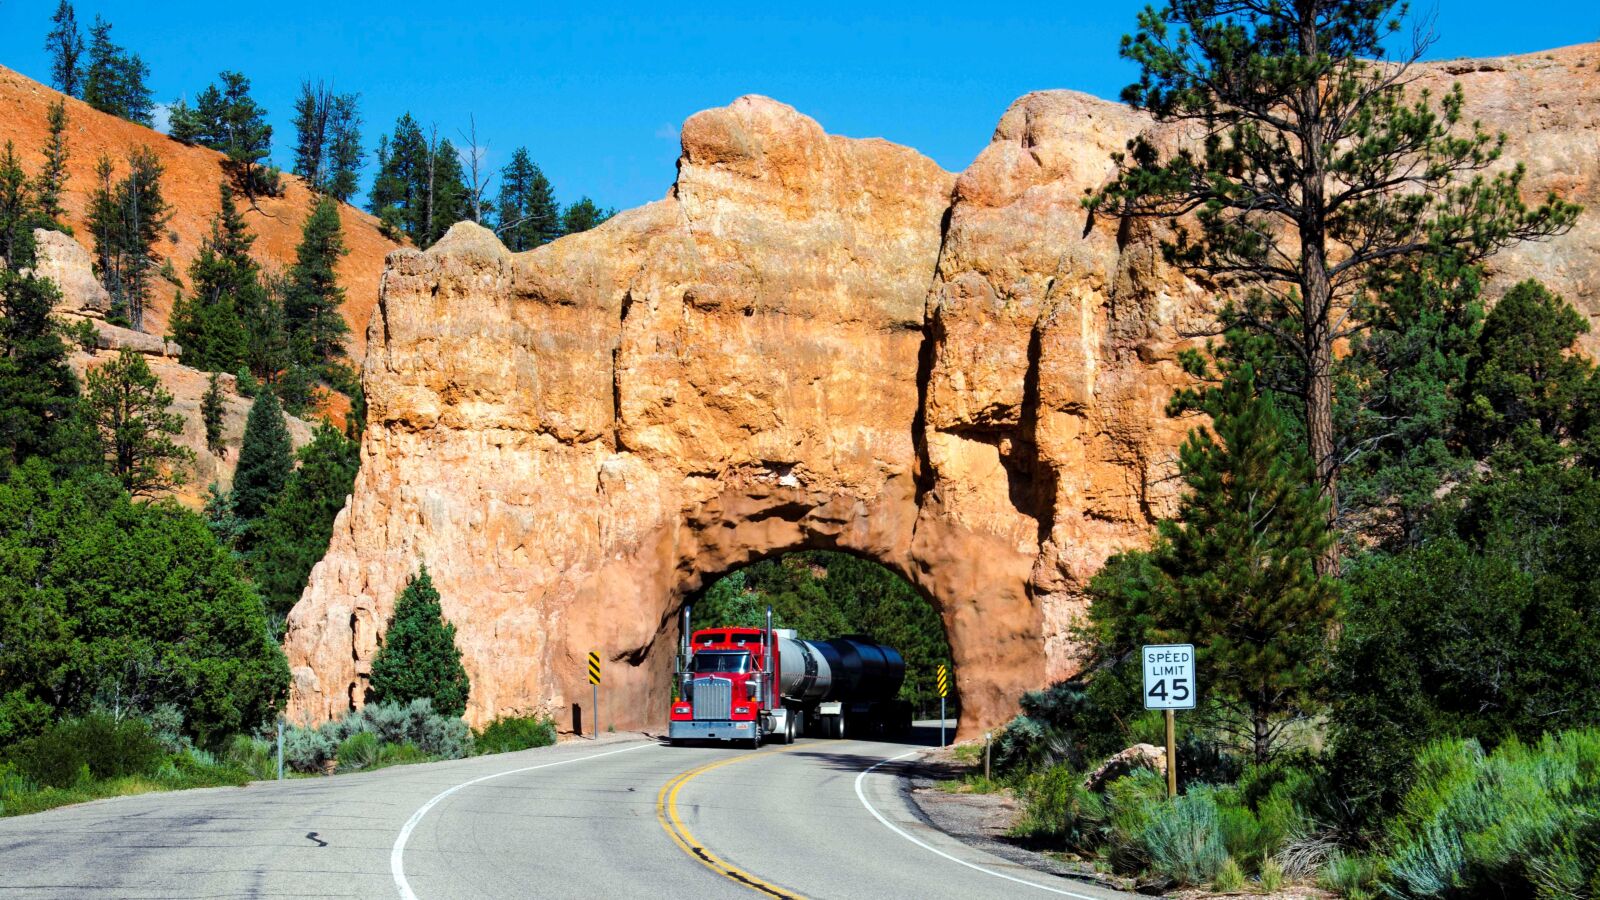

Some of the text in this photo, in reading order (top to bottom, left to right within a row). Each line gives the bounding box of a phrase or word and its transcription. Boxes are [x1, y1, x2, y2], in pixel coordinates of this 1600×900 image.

[1148, 653, 1189, 663] SPEED
[1152, 665, 1185, 676] LIMIT
[1148, 678, 1189, 701] 45
